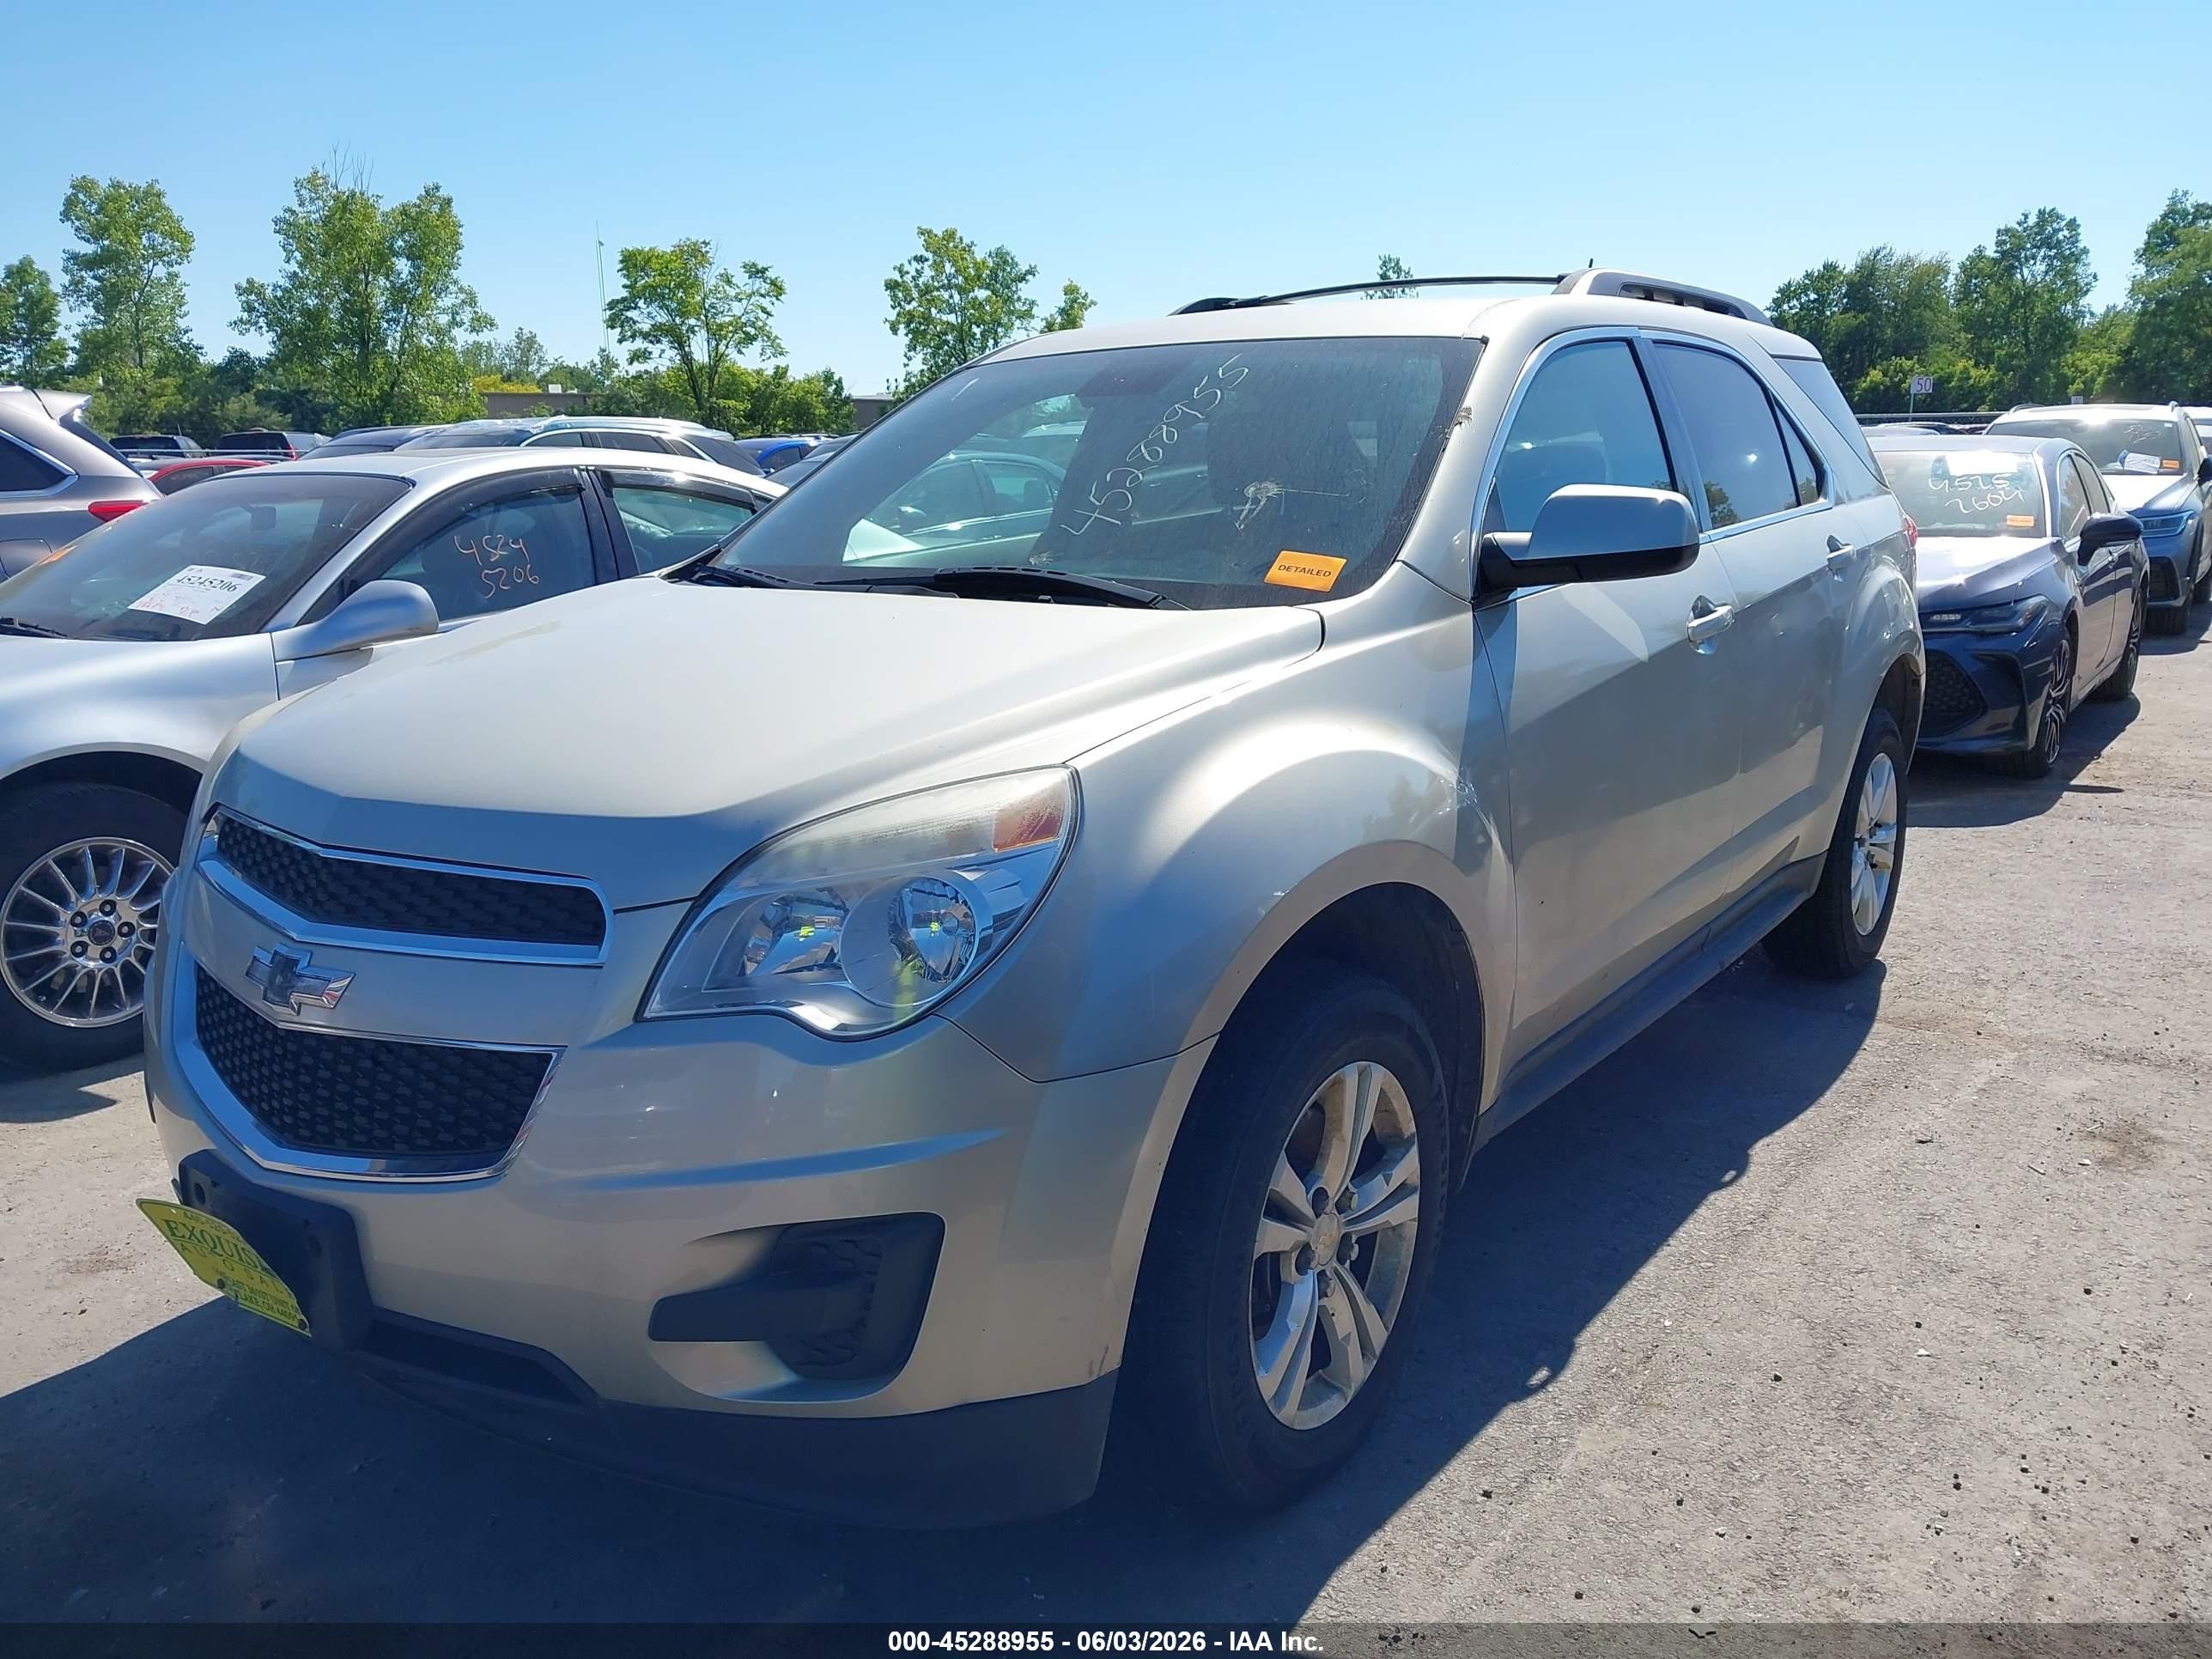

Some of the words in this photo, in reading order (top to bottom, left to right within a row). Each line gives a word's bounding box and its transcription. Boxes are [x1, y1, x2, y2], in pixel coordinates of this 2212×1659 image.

[1916, 377, 1932, 392] 50
[1060, 353, 1249, 536] 45288955
[1944, 489, 2027, 514] 2604
[453, 534, 531, 567] 4524
[176, 574, 240, 593] 45245206
[481, 563, 540, 599] 5206
[1277, 564, 1332, 578] DETAILED
